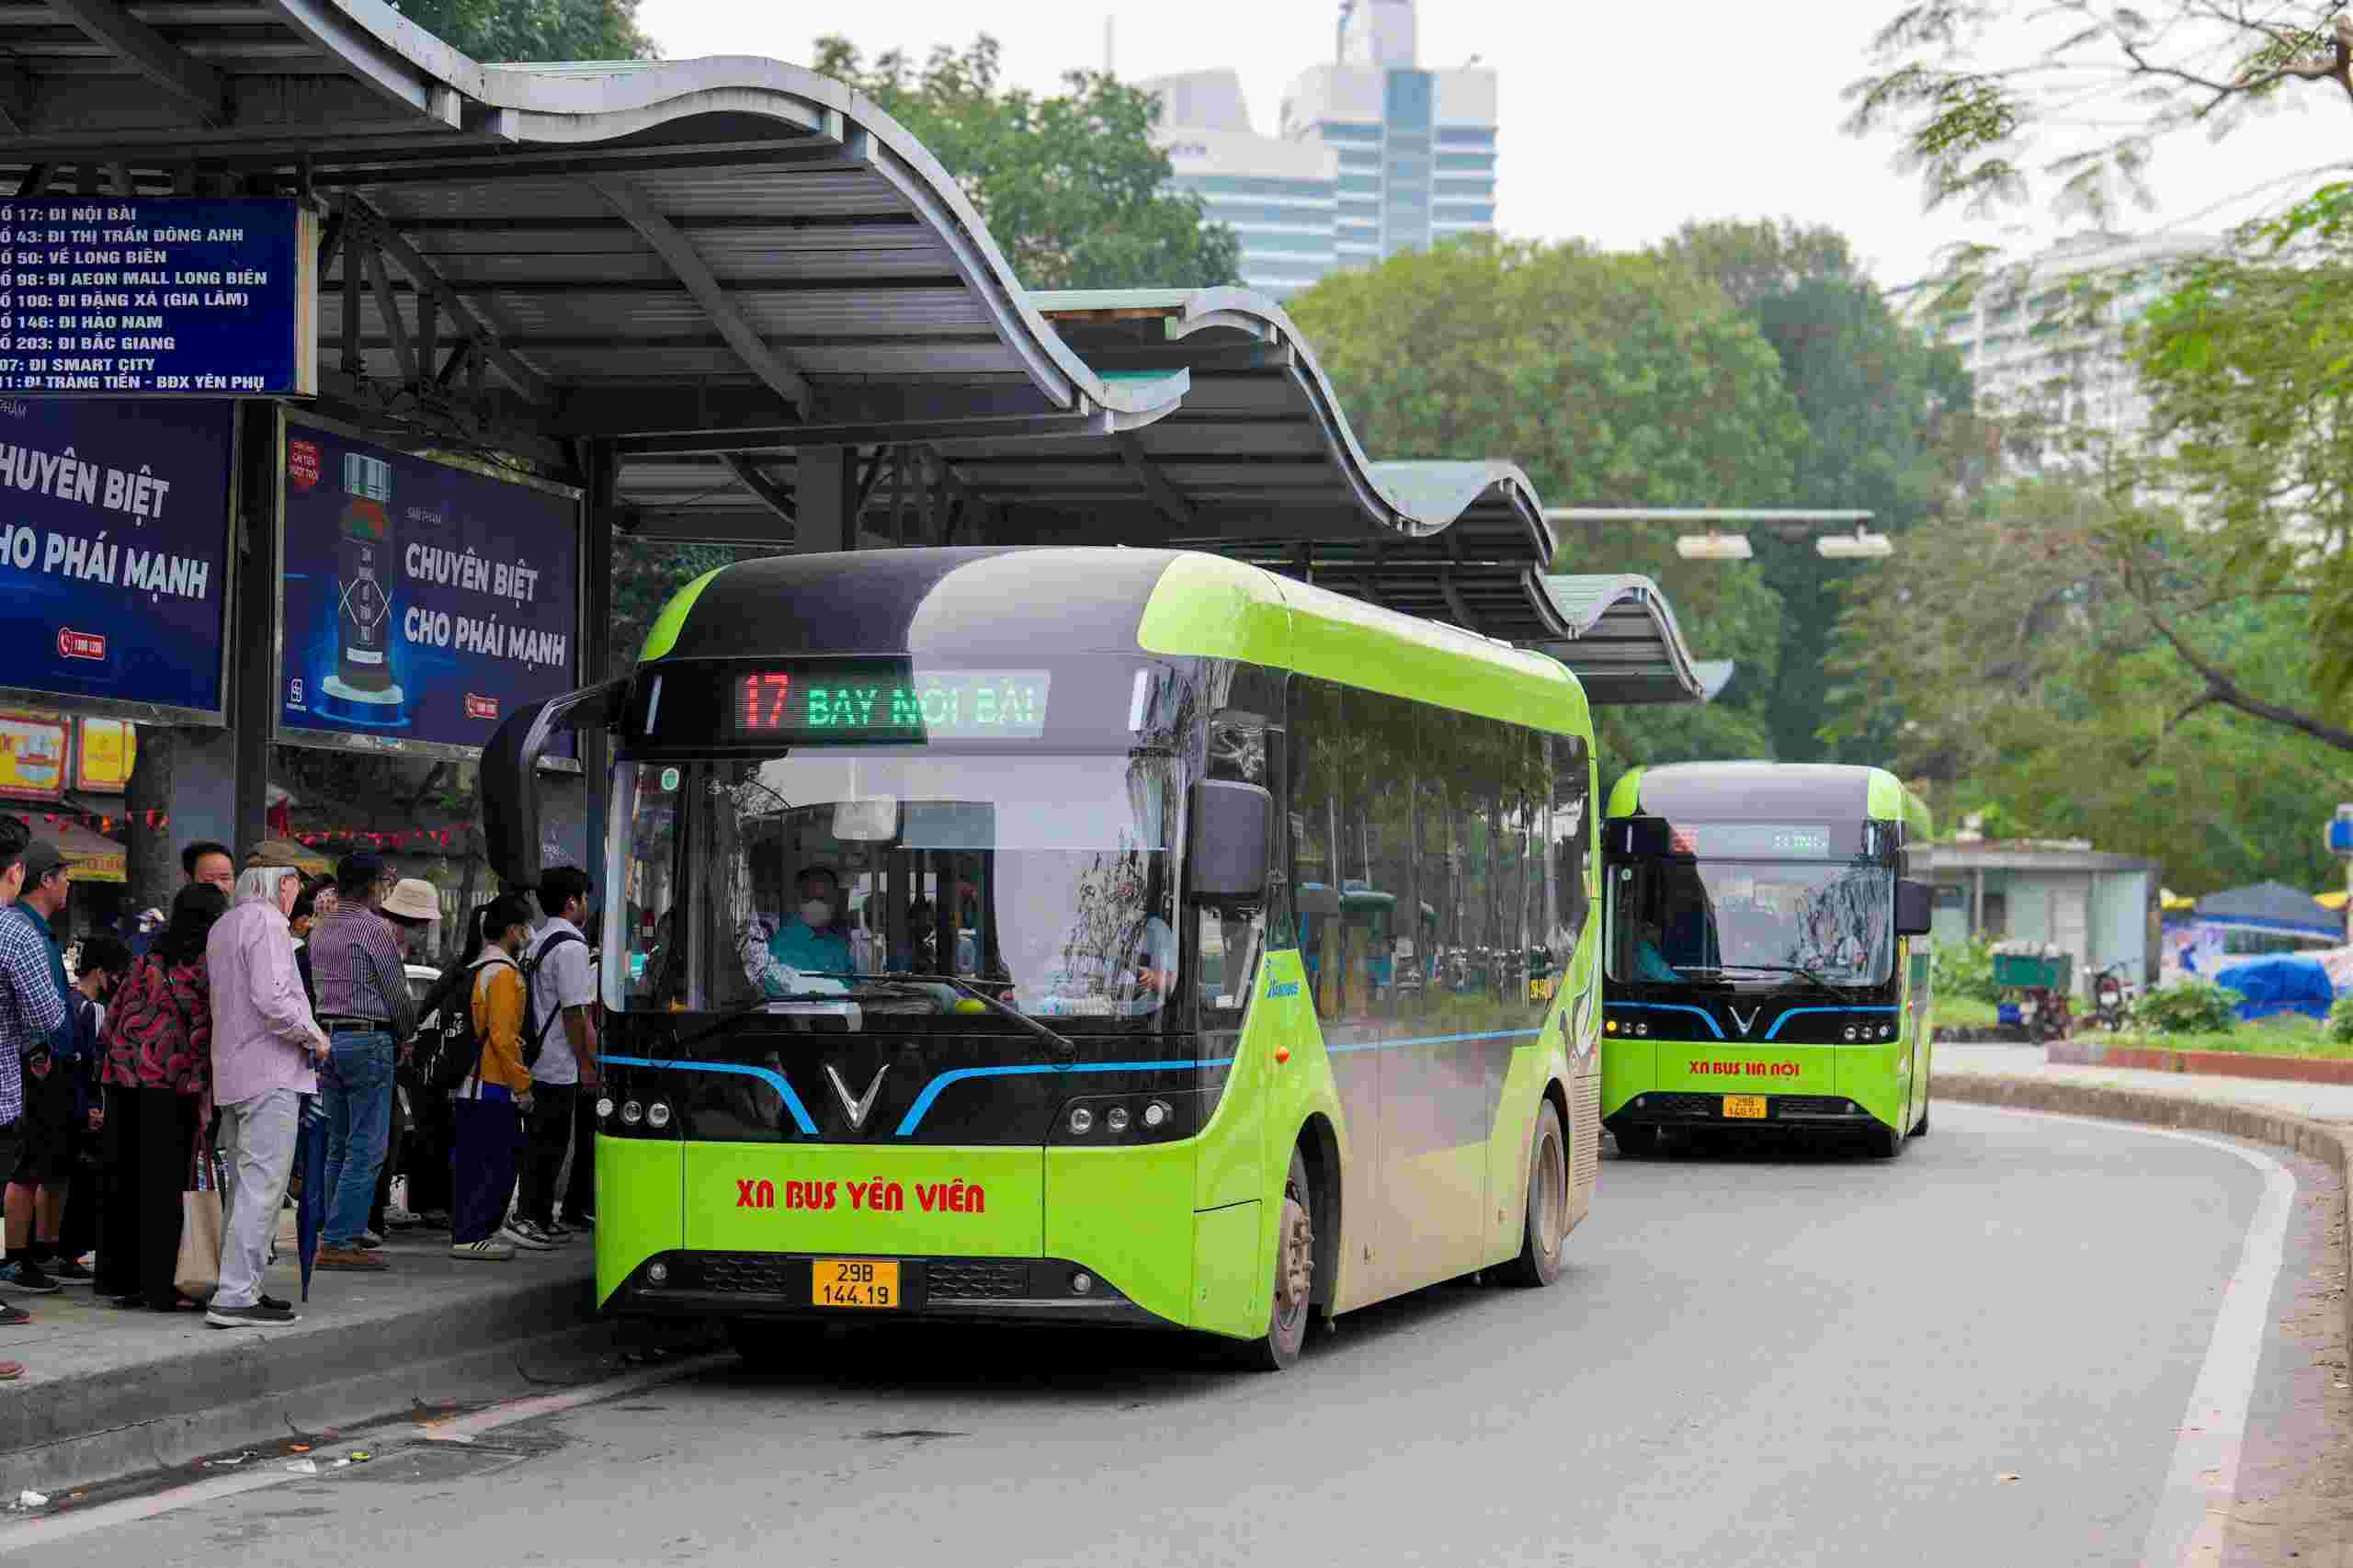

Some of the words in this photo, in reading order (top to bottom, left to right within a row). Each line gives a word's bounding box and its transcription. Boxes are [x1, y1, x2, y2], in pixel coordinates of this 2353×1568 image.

[18, 208, 43, 221] 17:
[49, 208, 66, 221] ĐI
[73, 205, 103, 223] NỘI
[17, 230, 42, 243] 43:
[48, 230, 65, 243] ĐI
[71, 230, 97, 244] THỊ
[153, 226, 201, 243] ĐÔNG
[207, 229, 243, 243] ANH
[17, 252, 43, 265] 50:
[74, 251, 120, 265] LONG
[126, 248, 166, 265] BIÊN
[17, 274, 44, 287] 98:
[48, 273, 65, 286] ĐI
[71, 272, 118, 286] AEON
[123, 272, 169, 285] MALL
[176, 272, 221, 285] LONG
[226, 267, 267, 285] BIÊN
[18, 294, 52, 308] 100:
[58, 294, 75, 307] ĐI
[163, 293, 199, 308] (GIA
[205, 290, 249, 308] LÂM)
[17, 315, 54, 329] 146:
[59, 315, 75, 329] ĐI
[121, 315, 163, 329] NAM
[17, 336, 52, 350] 203:
[58, 336, 75, 350] ĐI
[121, 336, 176, 350] GIANG
[29, 358, 47, 371] ĐI
[52, 358, 112, 371] SMART
[118, 358, 154, 371] CITY
[195, 372, 227, 389] YÊN
[103, 464, 170, 527] BIỆT
[42, 530, 119, 585] PHÁI
[122, 548, 210, 603] MẠNH
[405, 542, 490, 593] CHUYÊN
[493, 559, 539, 609] BIỆT
[404, 606, 450, 647] CHO
[455, 613, 505, 657] PHÁI
[507, 626, 567, 672] MẠNH
[743, 674, 789, 728] 17
[1712, 1061, 1740, 1074] BUS
[785, 1180, 837, 1210] BUS
[846, 1176, 904, 1211] YÊN
[915, 1177, 985, 1212] VIÊN
[837, 1264, 874, 1282] 29B
[823, 1286, 889, 1304] 144.19
